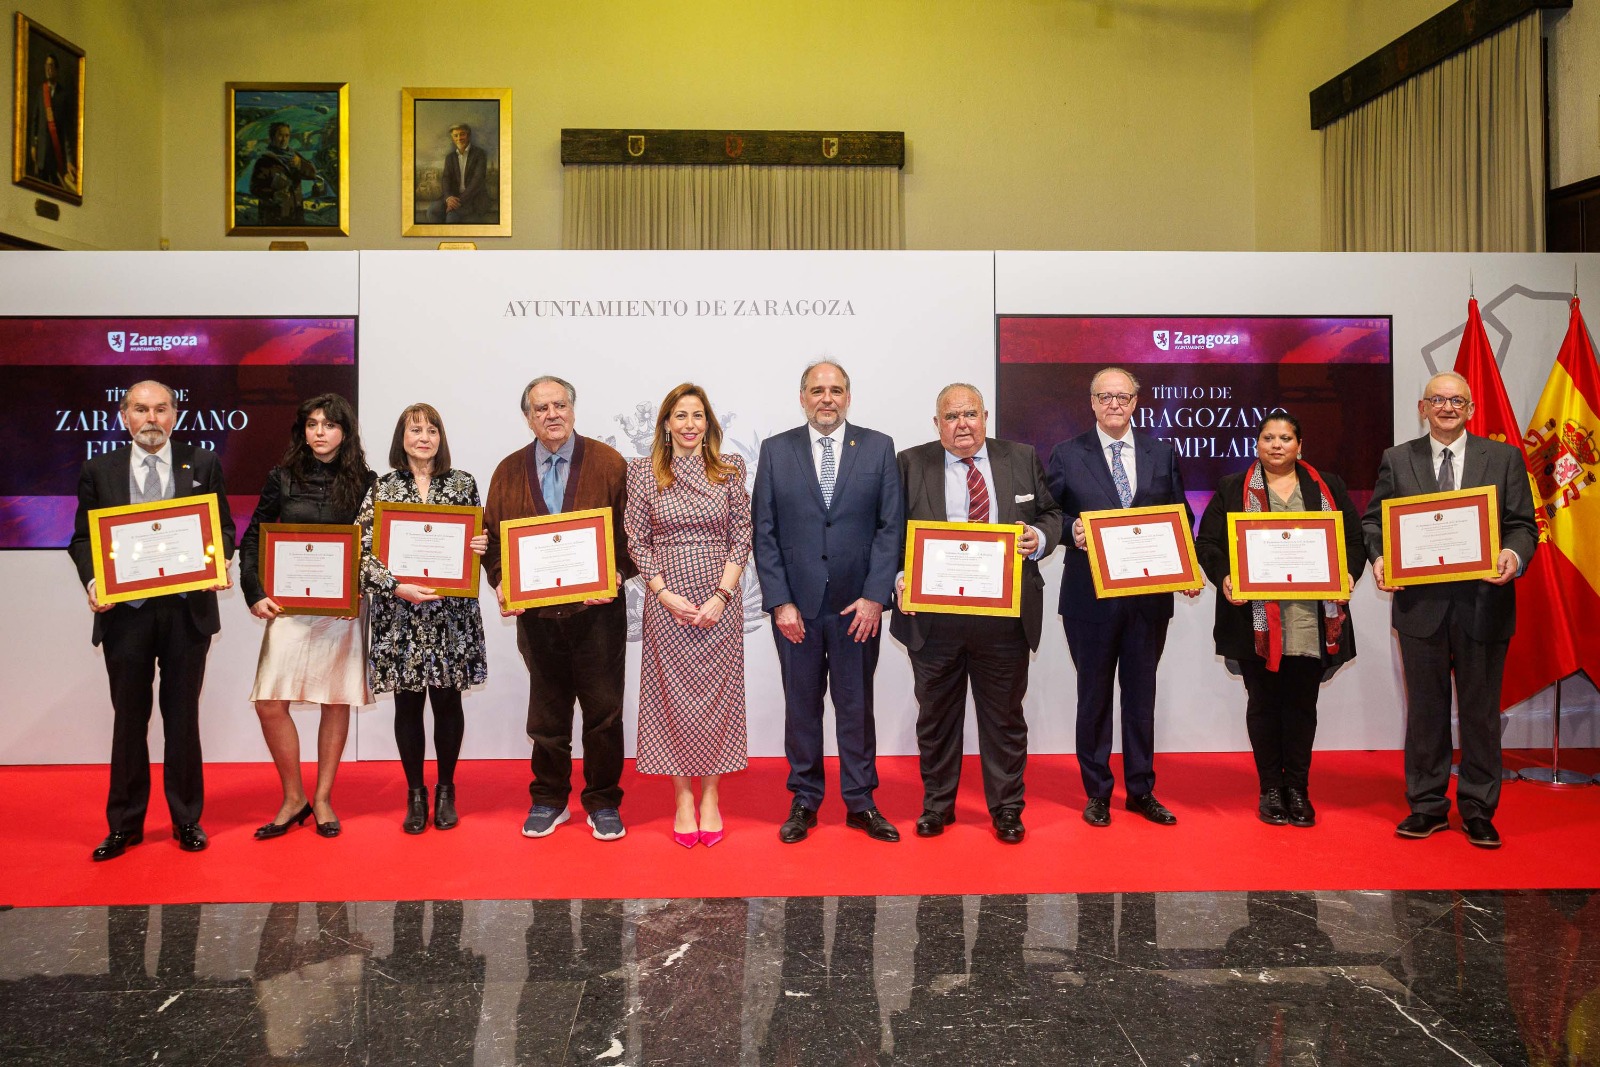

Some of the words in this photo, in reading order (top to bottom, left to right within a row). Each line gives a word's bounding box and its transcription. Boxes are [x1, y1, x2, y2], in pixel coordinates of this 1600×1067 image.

[503, 300, 688, 317] AYUNTAMIENTO
[696, 300, 727, 317] DE
[733, 299, 856, 316] ZARAGOZA
[129, 332, 197, 351] Zaragoza
[1174, 331, 1239, 349] Zaragoza
[1151, 384, 1204, 399] TÍTULO
[1209, 386, 1232, 399] DE
[55, 409, 249, 431] ZARAZANO
